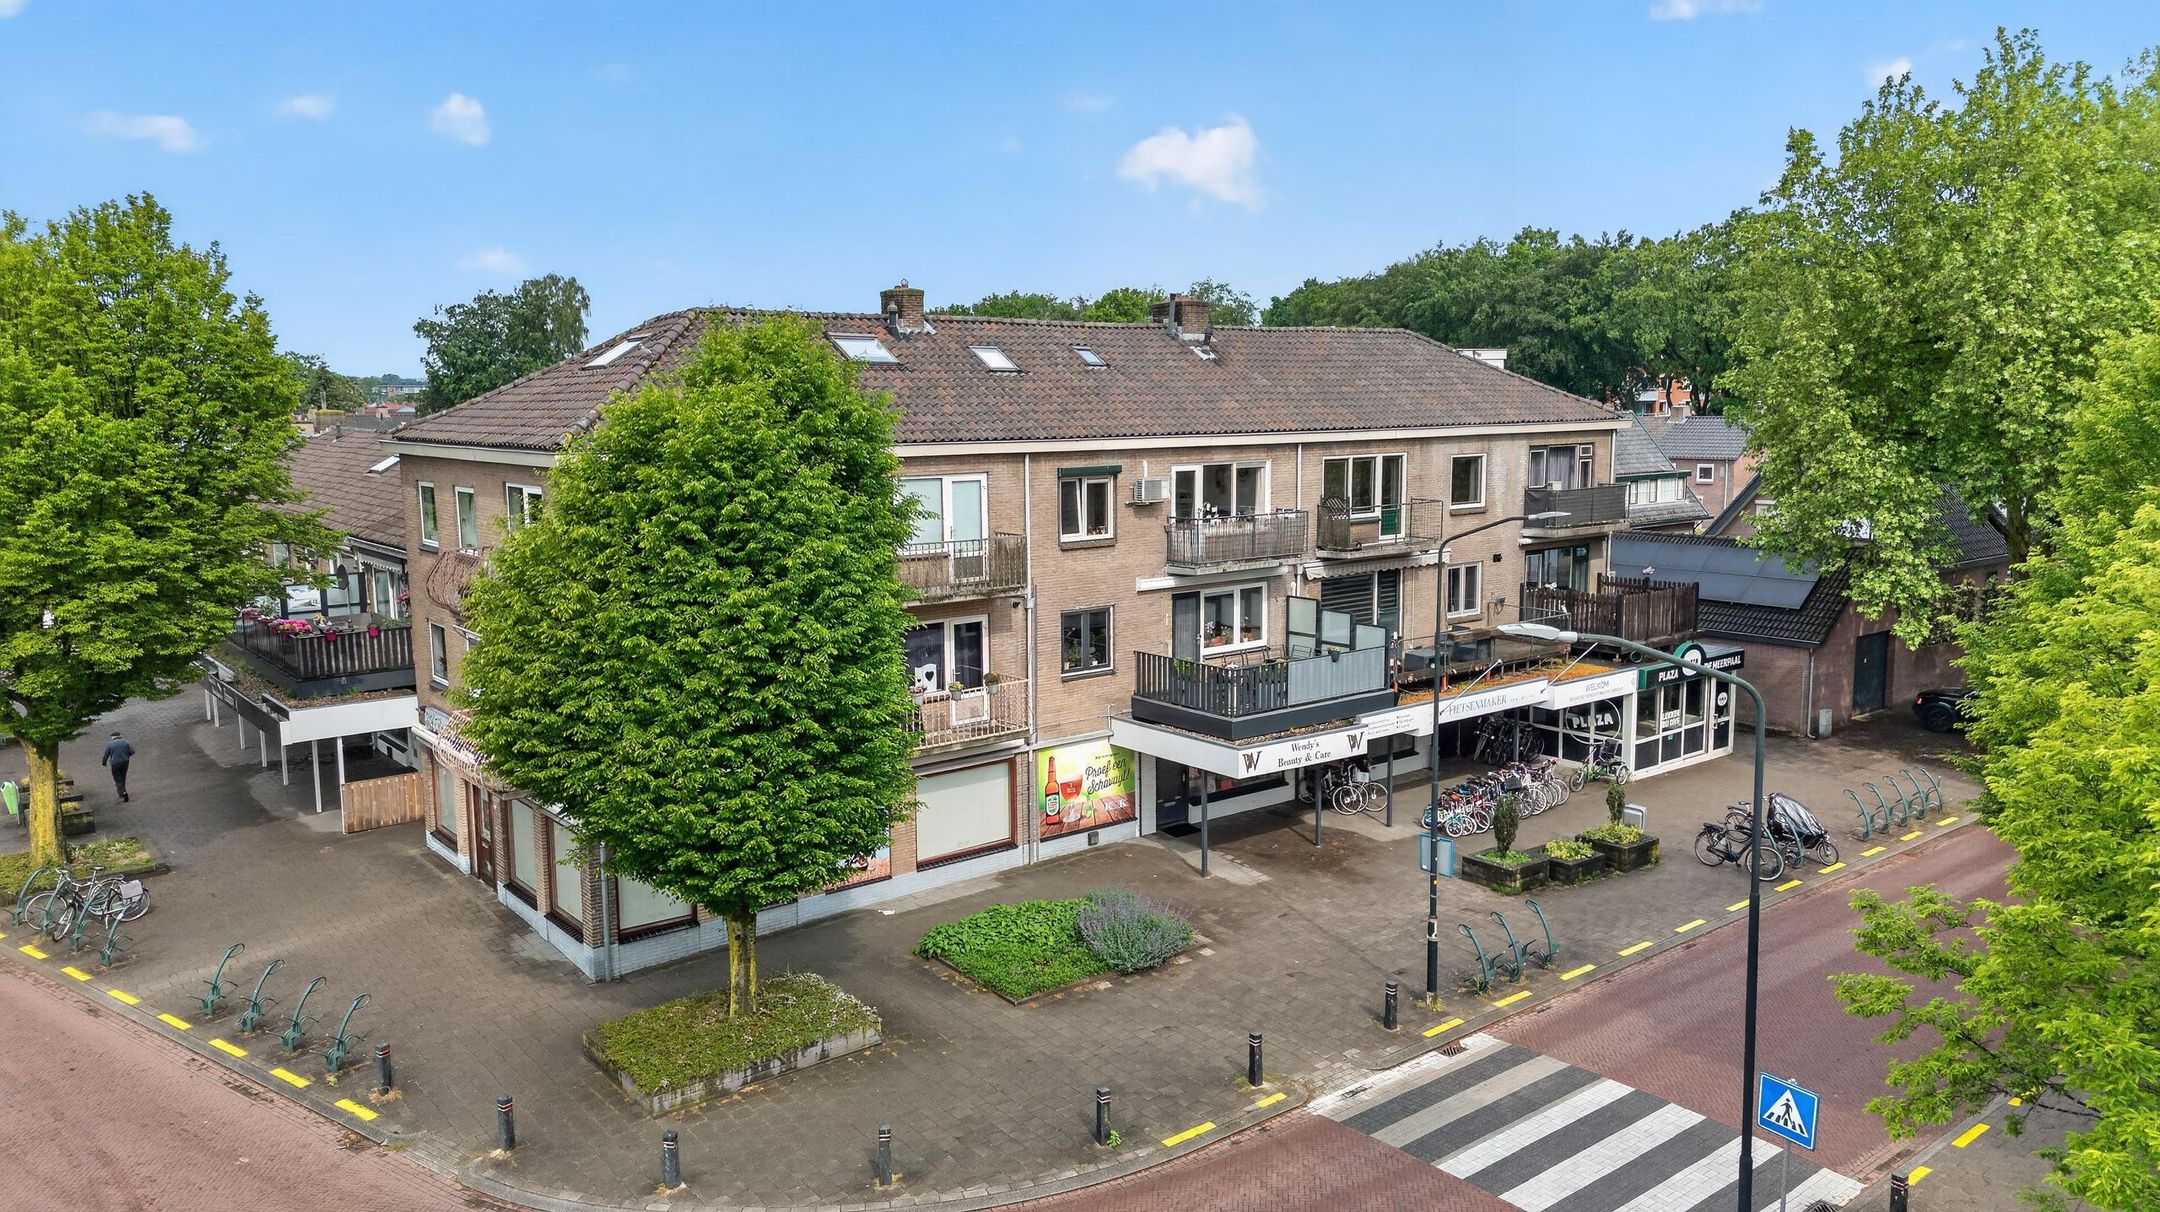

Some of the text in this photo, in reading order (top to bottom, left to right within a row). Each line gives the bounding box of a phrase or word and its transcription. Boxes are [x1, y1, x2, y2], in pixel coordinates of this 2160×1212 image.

[1658, 668, 1679, 682] PLAZA
[1448, 694, 1507, 716] FIETSENMAKER
[1291, 739, 1320, 753] Wendy's
[1278, 750, 1332, 768] Beauty & Care
[1085, 758, 1126, 780] Proef een
